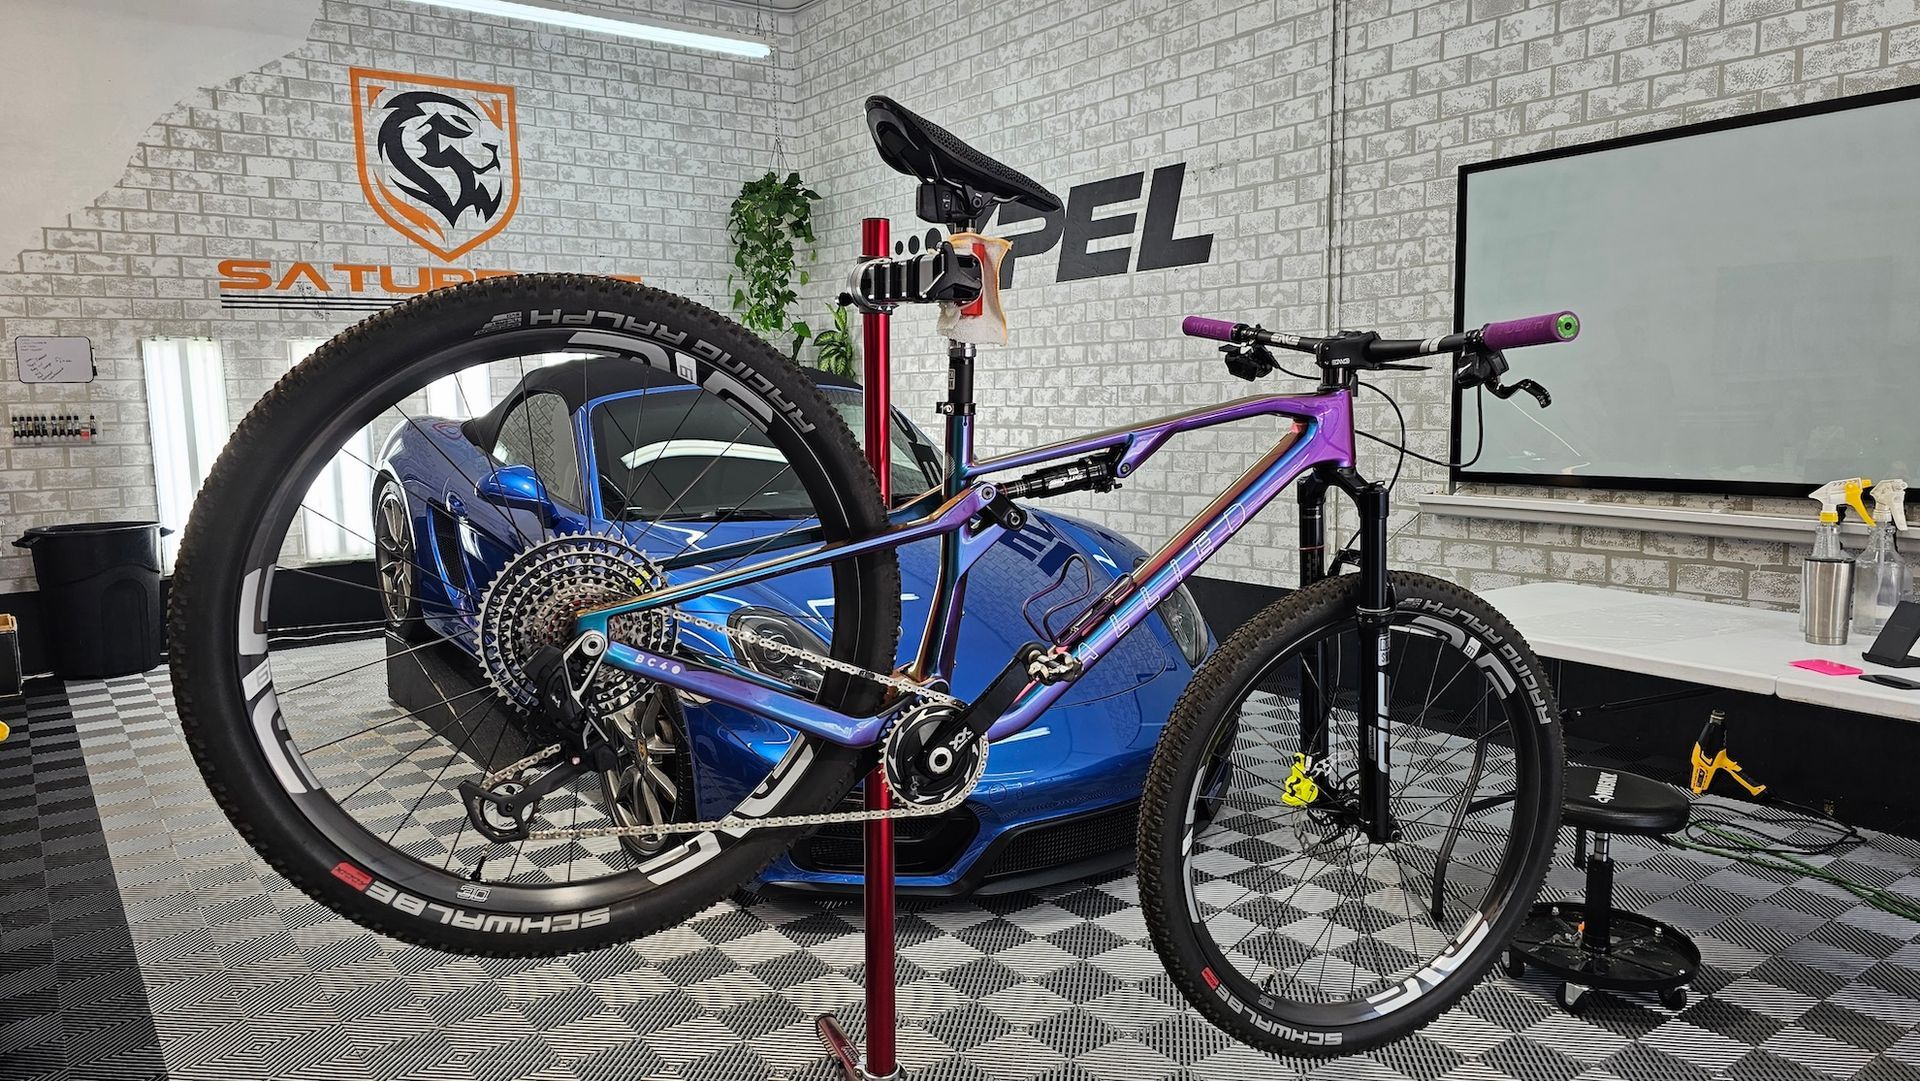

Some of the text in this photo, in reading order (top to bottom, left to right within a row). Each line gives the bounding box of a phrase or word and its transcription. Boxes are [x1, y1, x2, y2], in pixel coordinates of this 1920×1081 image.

[952, 162, 1214, 290] PEL
[530, 308, 688, 347] RALPH
[694, 338, 817, 434] RACING
[1077, 502, 1246, 661] ALLIED
[1424, 600, 1504, 644] RALPH
[1499, 643, 1552, 725] RACING
[365, 879, 611, 934] SCHWALBE
[1215, 983, 1343, 1047] SCHWALBE
